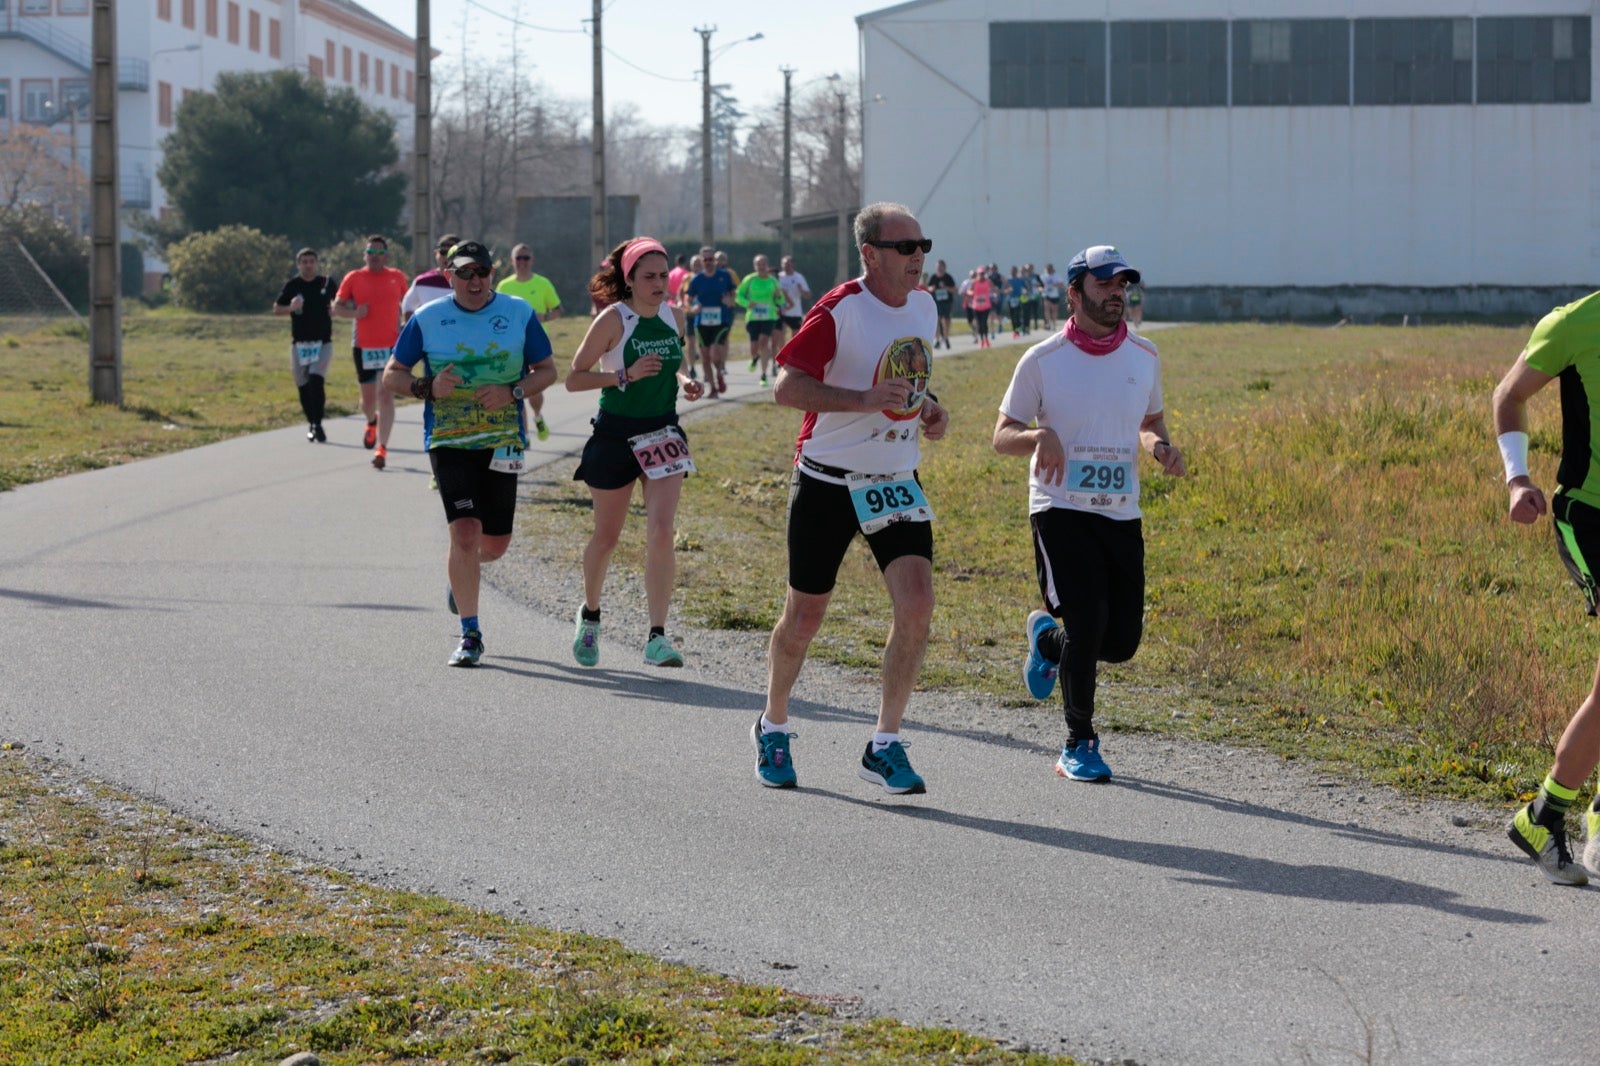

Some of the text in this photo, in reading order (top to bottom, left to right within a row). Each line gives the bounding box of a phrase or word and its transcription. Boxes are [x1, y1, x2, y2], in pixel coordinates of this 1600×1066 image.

[639, 440, 688, 467] 2108
[1079, 465, 1125, 490] 299
[865, 485, 914, 513] 983
